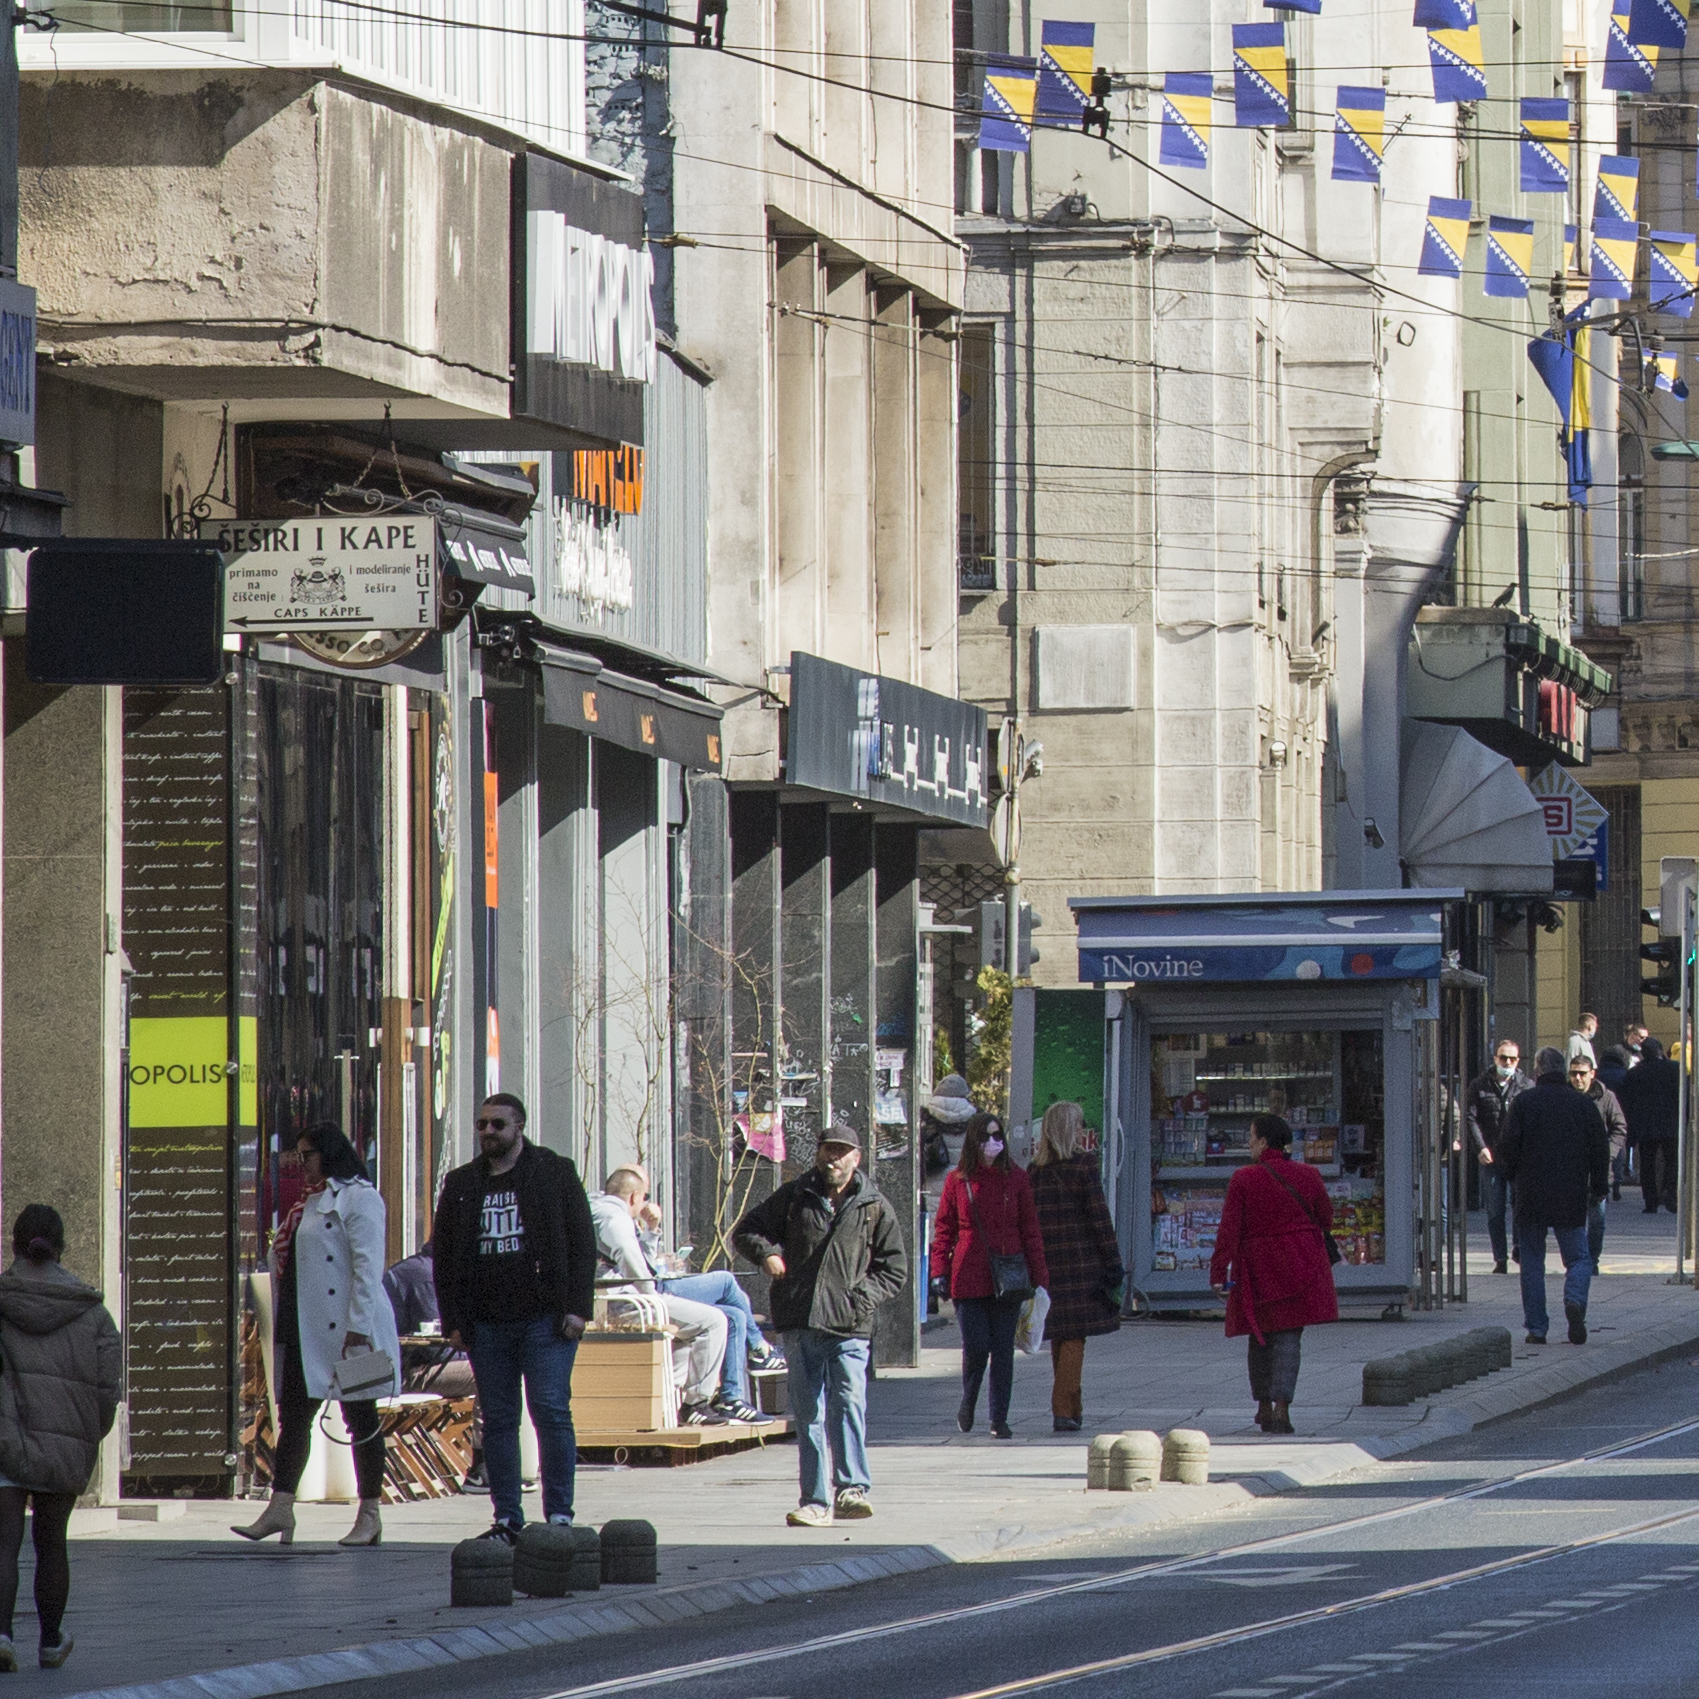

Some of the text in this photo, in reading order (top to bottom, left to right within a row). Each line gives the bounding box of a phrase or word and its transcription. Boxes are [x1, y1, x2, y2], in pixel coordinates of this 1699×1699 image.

[218, 522, 417, 552] ŠEŠIRI I KAPE
[229, 567, 278, 580] primamo
[356, 564, 412, 576] modeliranje
[247, 581, 260, 590] na
[364, 582, 396, 593] šešira
[415, 554, 430, 623] HÜTE
[274, 604, 362, 618] CAPS KÄPPE
[1103, 954, 1204, 978] iNovine
[497, 1237, 519, 1253] BED
